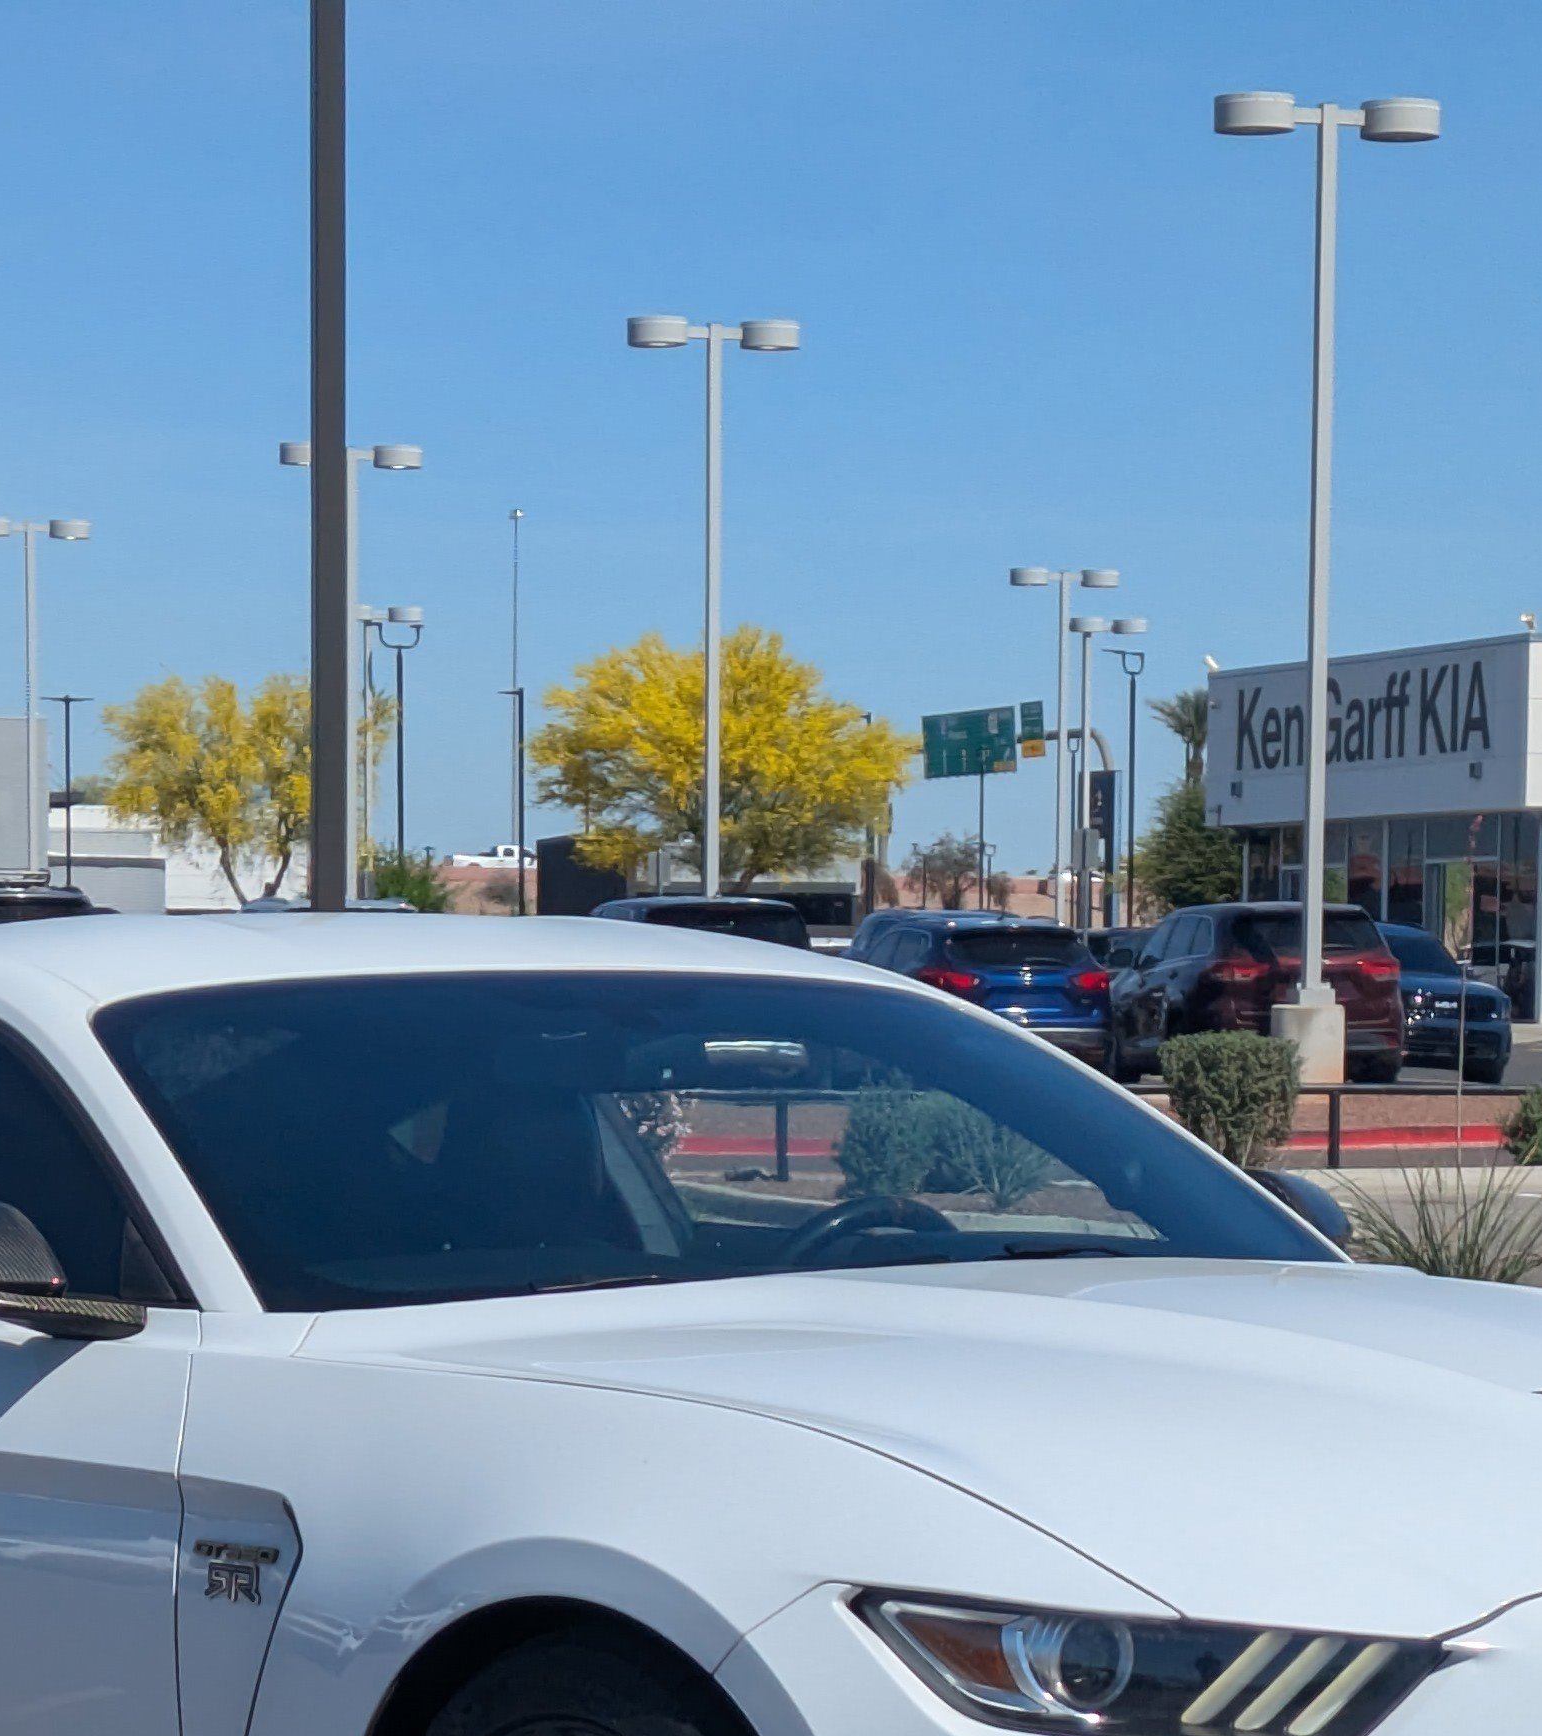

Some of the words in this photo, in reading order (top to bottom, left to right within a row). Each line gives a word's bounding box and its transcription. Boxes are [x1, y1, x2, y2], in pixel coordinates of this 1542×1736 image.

[1236, 686, 1304, 771] Ken
[1326, 669, 1411, 765] Garff
[1419, 660, 1491, 756] KIA
